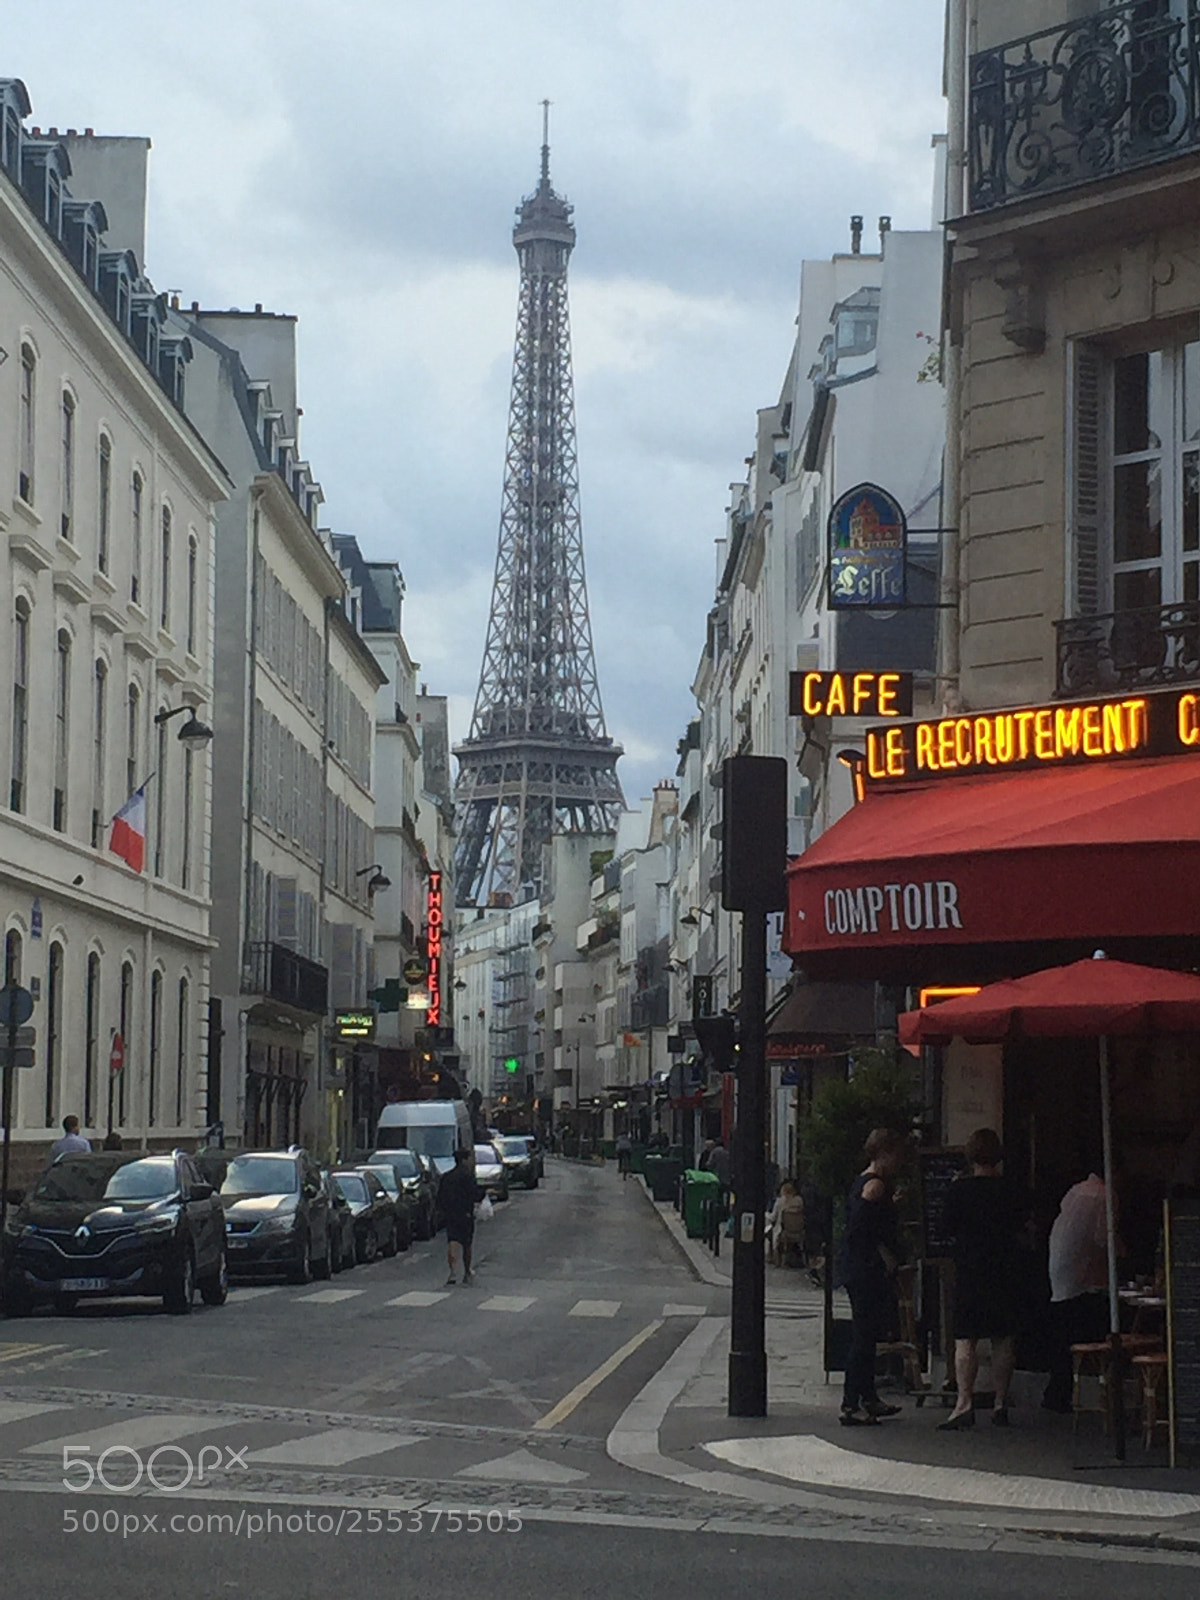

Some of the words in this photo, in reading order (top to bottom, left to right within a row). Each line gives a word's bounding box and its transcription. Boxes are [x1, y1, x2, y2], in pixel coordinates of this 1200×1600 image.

[831, 564, 901, 600] Leffe
[803, 672, 900, 716] CAFE
[867, 728, 905, 779] LE
[916, 699, 1145, 771] RECRUTEMENT
[824, 880, 963, 934] COMPTOIR
